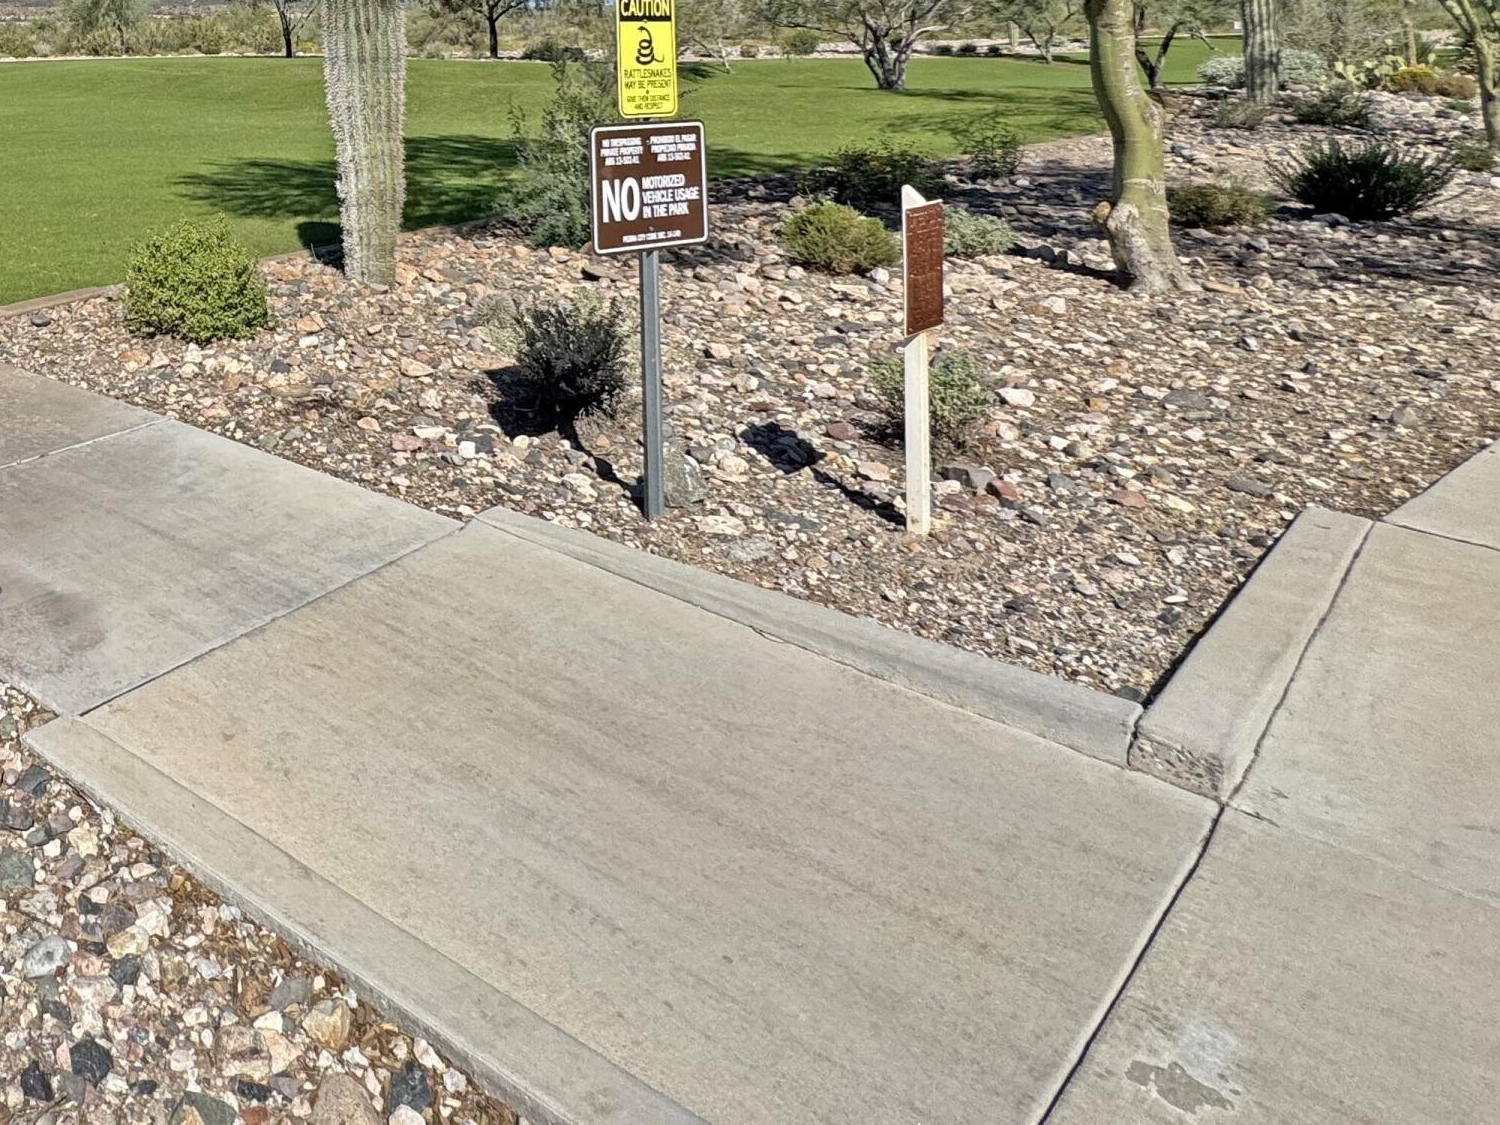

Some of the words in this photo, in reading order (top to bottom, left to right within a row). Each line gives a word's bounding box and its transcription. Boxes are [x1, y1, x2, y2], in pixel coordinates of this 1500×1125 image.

[624, 68, 671, 79] RATTLESNAKES
[624, 80, 636, 89] MAY
[638, 80, 646, 89] BE
[647, 79, 671, 88] PRESENT
[641, 174, 685, 189] MOTORIZED
[602, 177, 640, 223] NO
[642, 189, 673, 204] VEHICLE
[674, 186, 700, 201] USAGE
[643, 205, 652, 219] IN
[652, 204, 668, 218] THE
[668, 202, 690, 216] PARK
